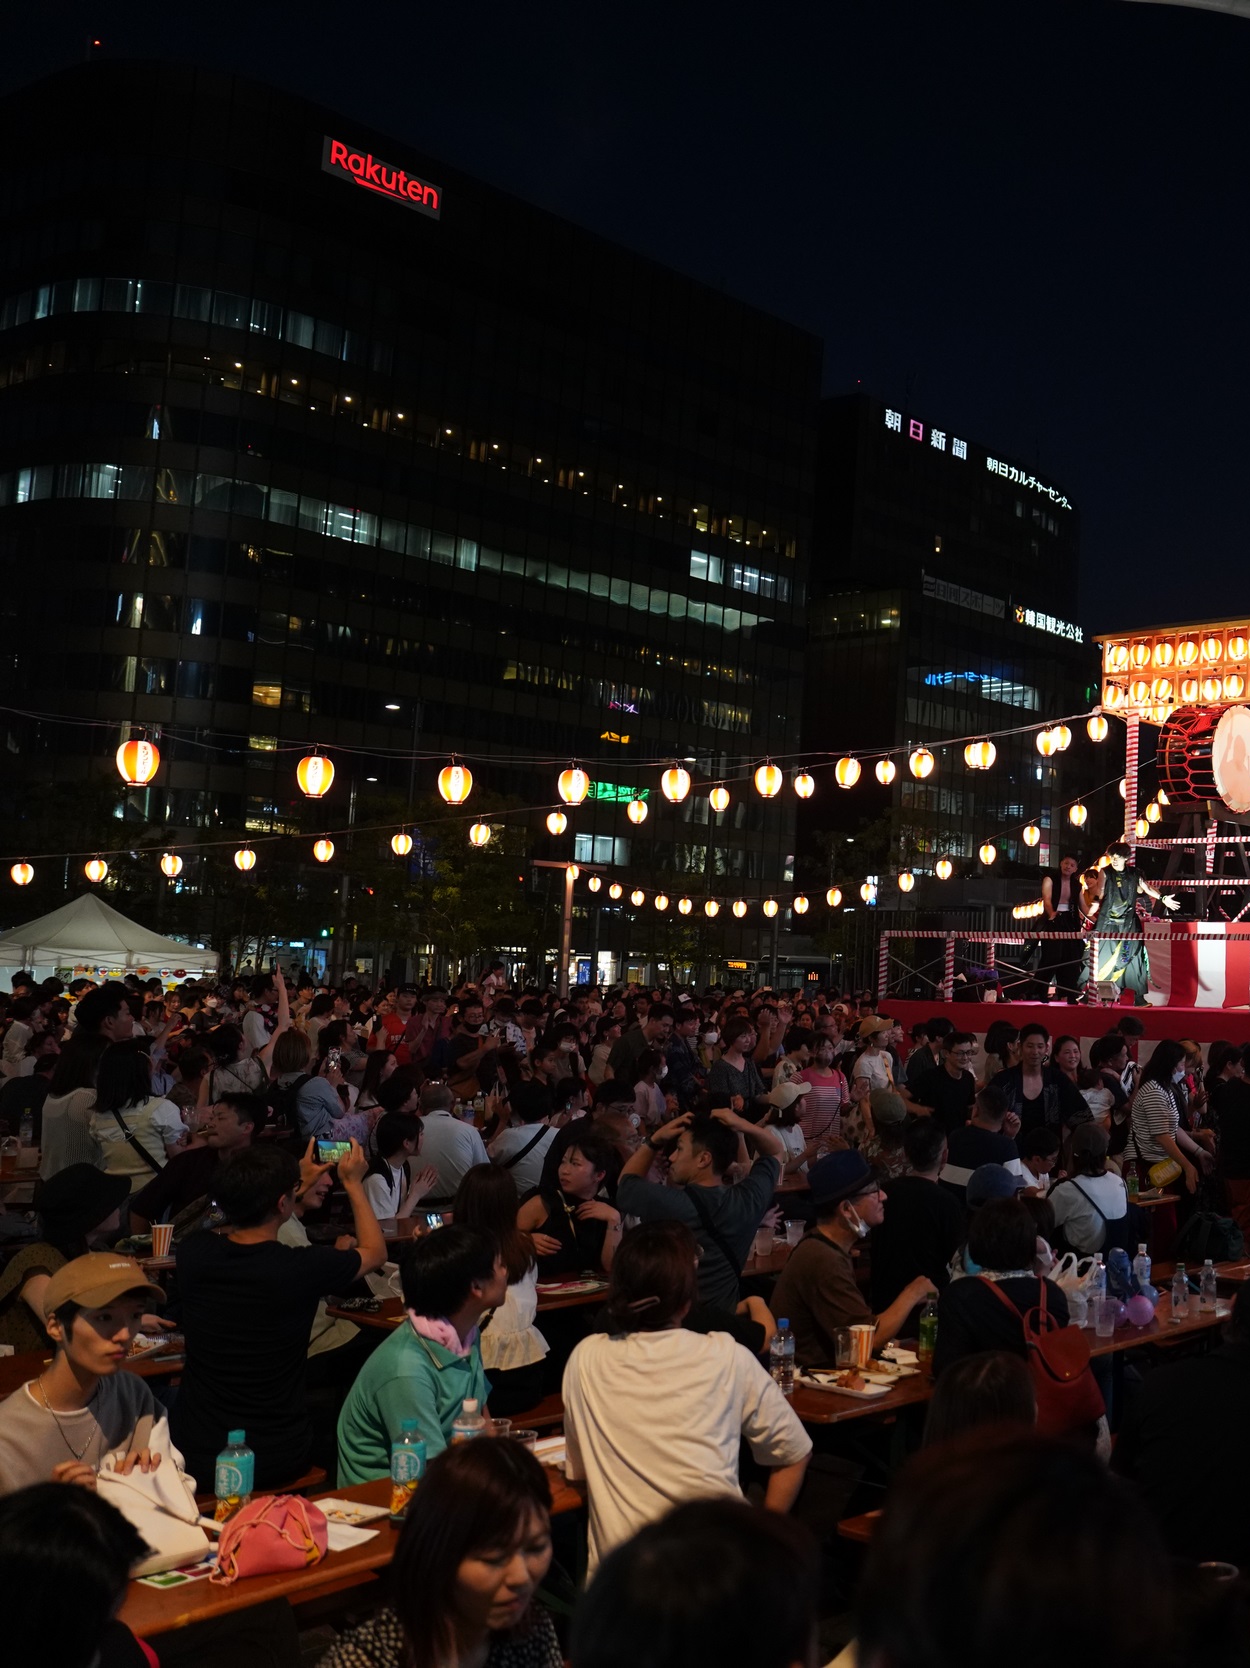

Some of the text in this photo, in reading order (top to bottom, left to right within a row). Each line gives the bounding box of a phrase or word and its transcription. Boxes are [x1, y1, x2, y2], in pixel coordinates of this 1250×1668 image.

[330, 139, 439, 210] Rakuten
[885, 408, 968, 461] 朝日新聞
[986, 456, 1073, 511] 朝日カルチャーセンター
[1025, 608, 1084, 644] 韓国観光公社
